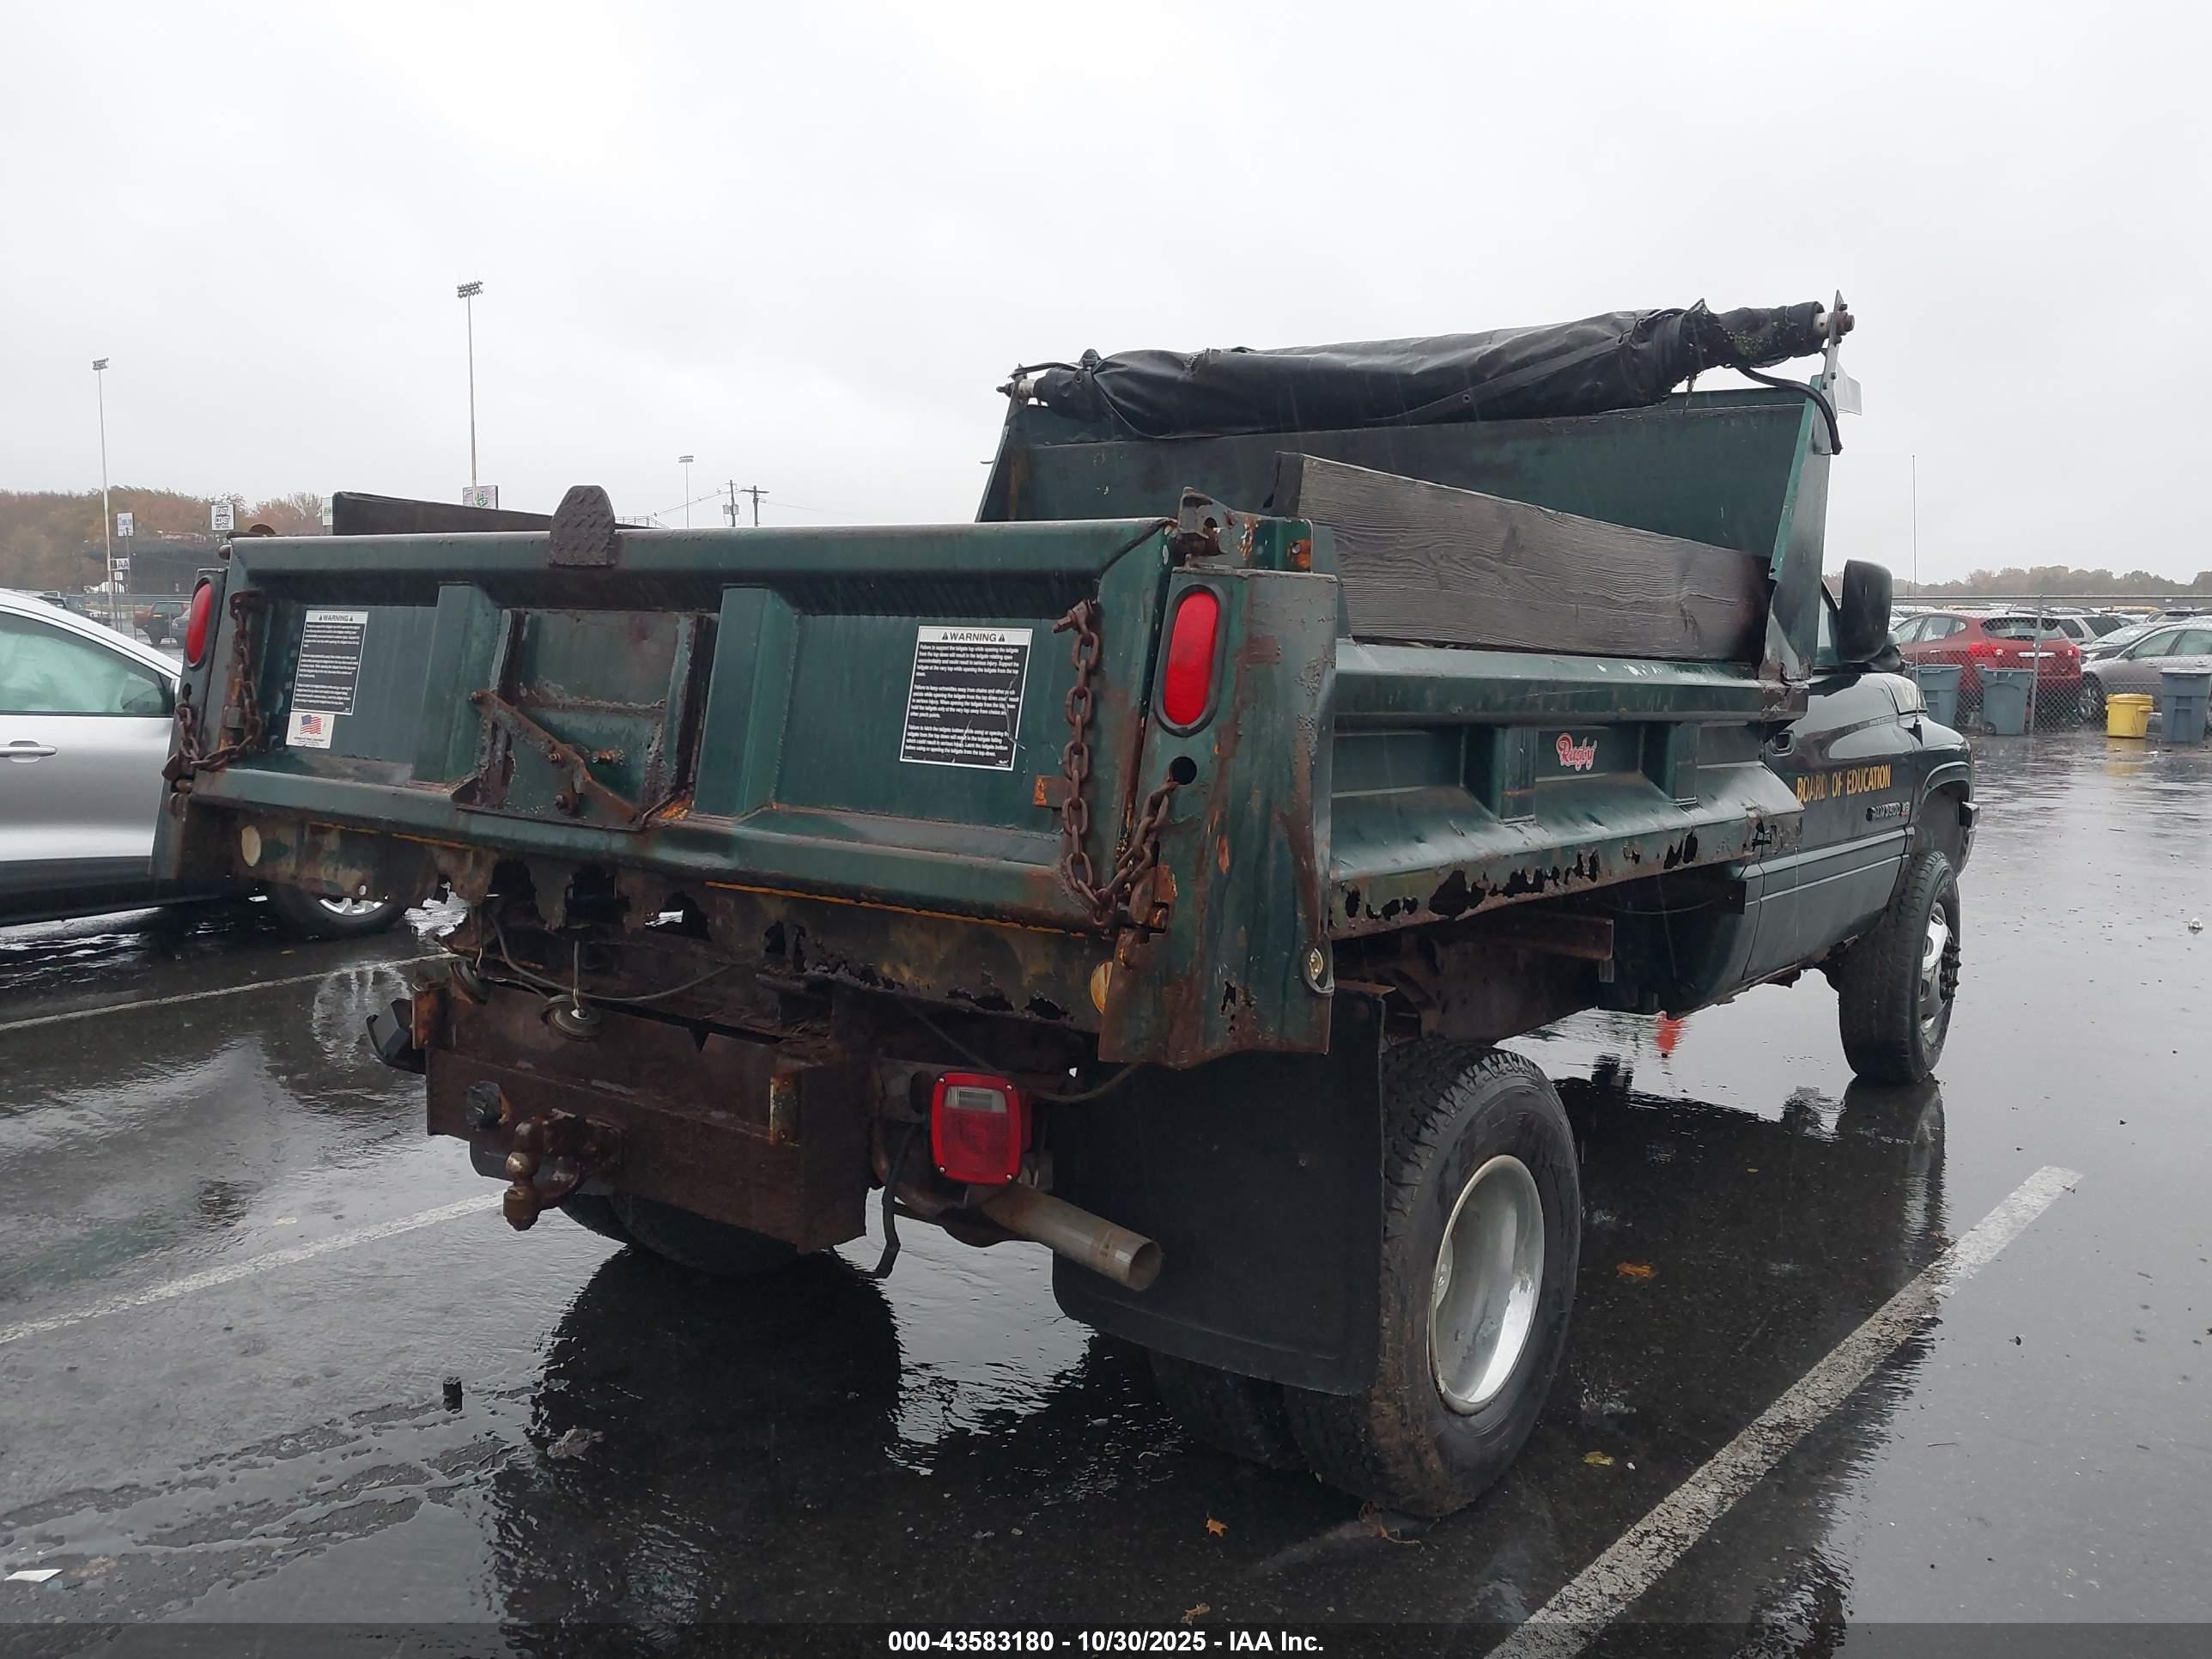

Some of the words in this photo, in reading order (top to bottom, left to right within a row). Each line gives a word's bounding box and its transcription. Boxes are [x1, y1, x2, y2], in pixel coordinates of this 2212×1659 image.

[950, 632, 997, 642] WARNING
[1832, 771, 1844, 798] OF
[1847, 764, 1892, 795] EDUCATION
